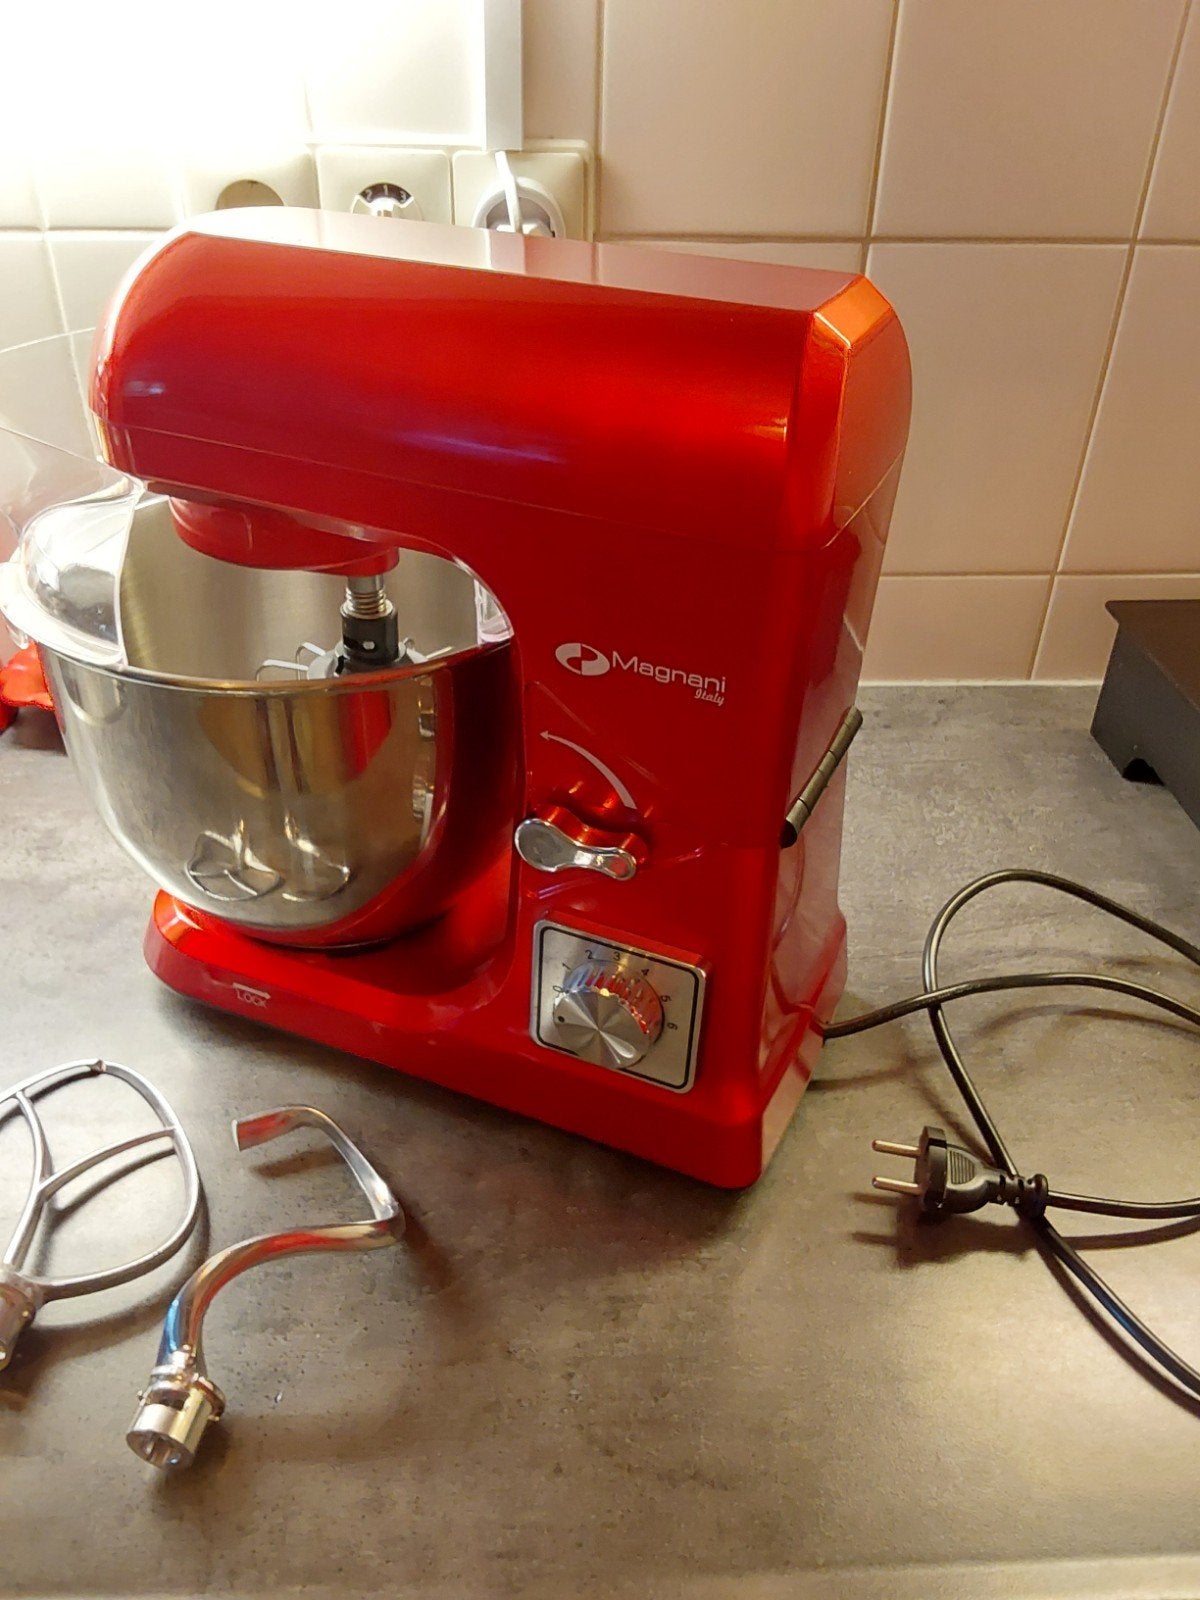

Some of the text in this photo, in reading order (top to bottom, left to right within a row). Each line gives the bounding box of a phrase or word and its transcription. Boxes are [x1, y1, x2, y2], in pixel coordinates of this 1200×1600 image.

[612, 650, 726, 693] Magnani
[694, 688, 725, 707] Italy
[584, 949, 594, 960] 2
[612, 951, 621, 961] 3
[640, 968, 650, 977] 4
[659, 995, 672, 1003] 5
[666, 1022, 678, 1031] 6
